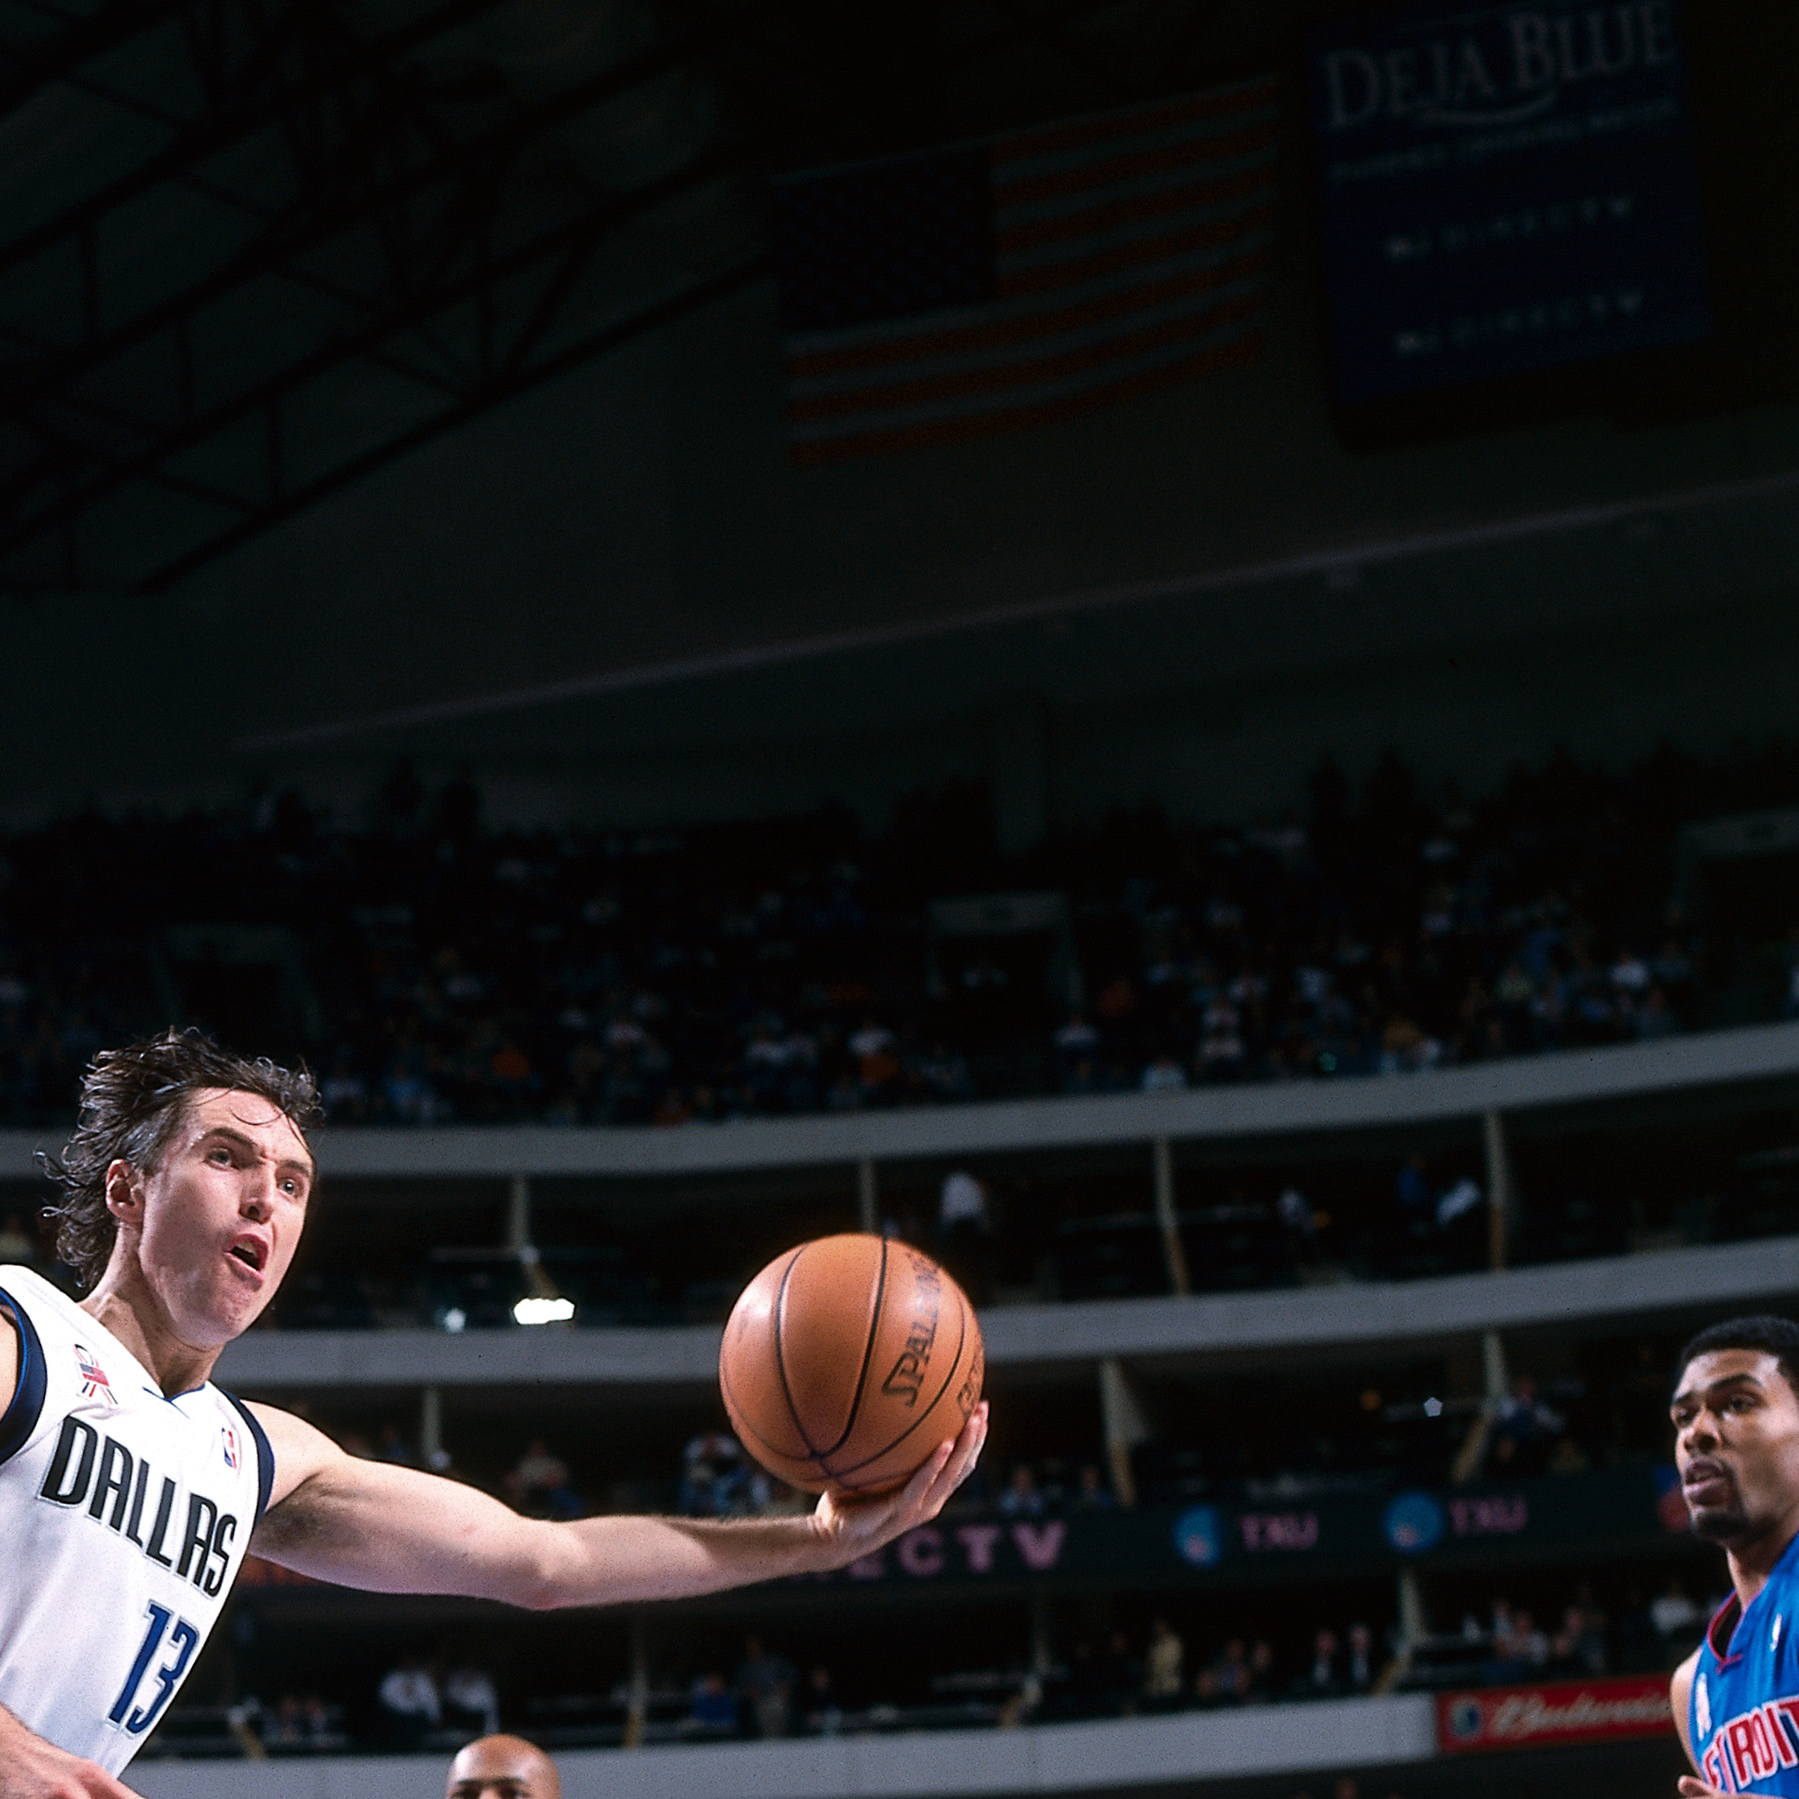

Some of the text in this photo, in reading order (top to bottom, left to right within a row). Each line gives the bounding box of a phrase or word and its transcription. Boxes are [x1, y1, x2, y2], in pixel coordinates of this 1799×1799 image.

[1506, 0, 1677, 90] BLUE
[37, 1413, 238, 1600] DALLAS
[105, 1600, 200, 1738] 13
